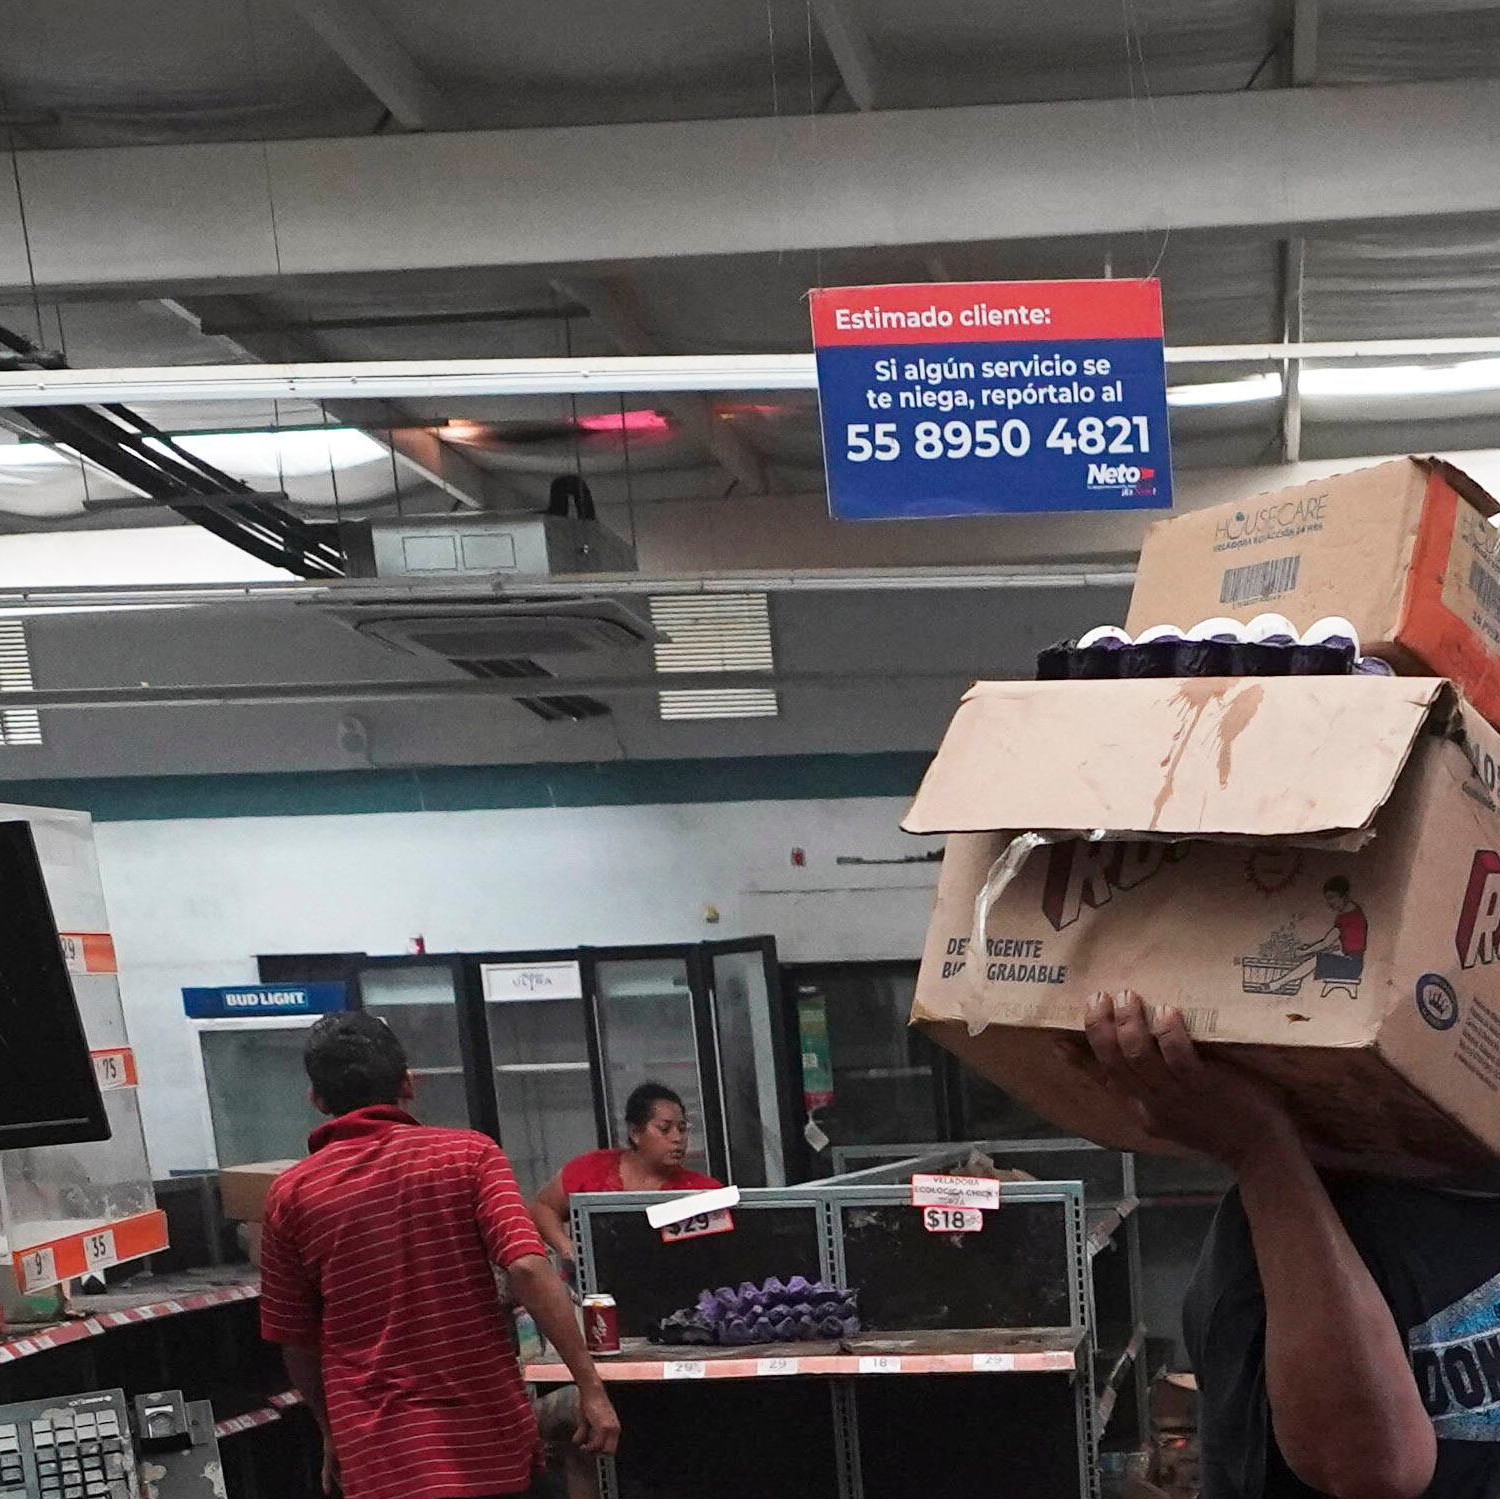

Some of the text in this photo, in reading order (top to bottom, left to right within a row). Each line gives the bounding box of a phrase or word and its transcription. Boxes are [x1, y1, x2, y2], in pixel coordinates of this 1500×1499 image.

[835, 304, 1052, 331] Estimado cliente:
[874, 356, 1111, 386] Si algún servicio se
[867, 381, 1124, 413] te niega, repórtalo al
[846, 415, 1151, 462] 55 8950 4821
[1087, 463, 1141, 485] Neto
[225, 991, 305, 1006] BUD LIGHT
[102, 1057, 118, 1081] 75
[927, 1208, 965, 1229] $18
[872, 1358, 887, 1368] 18
